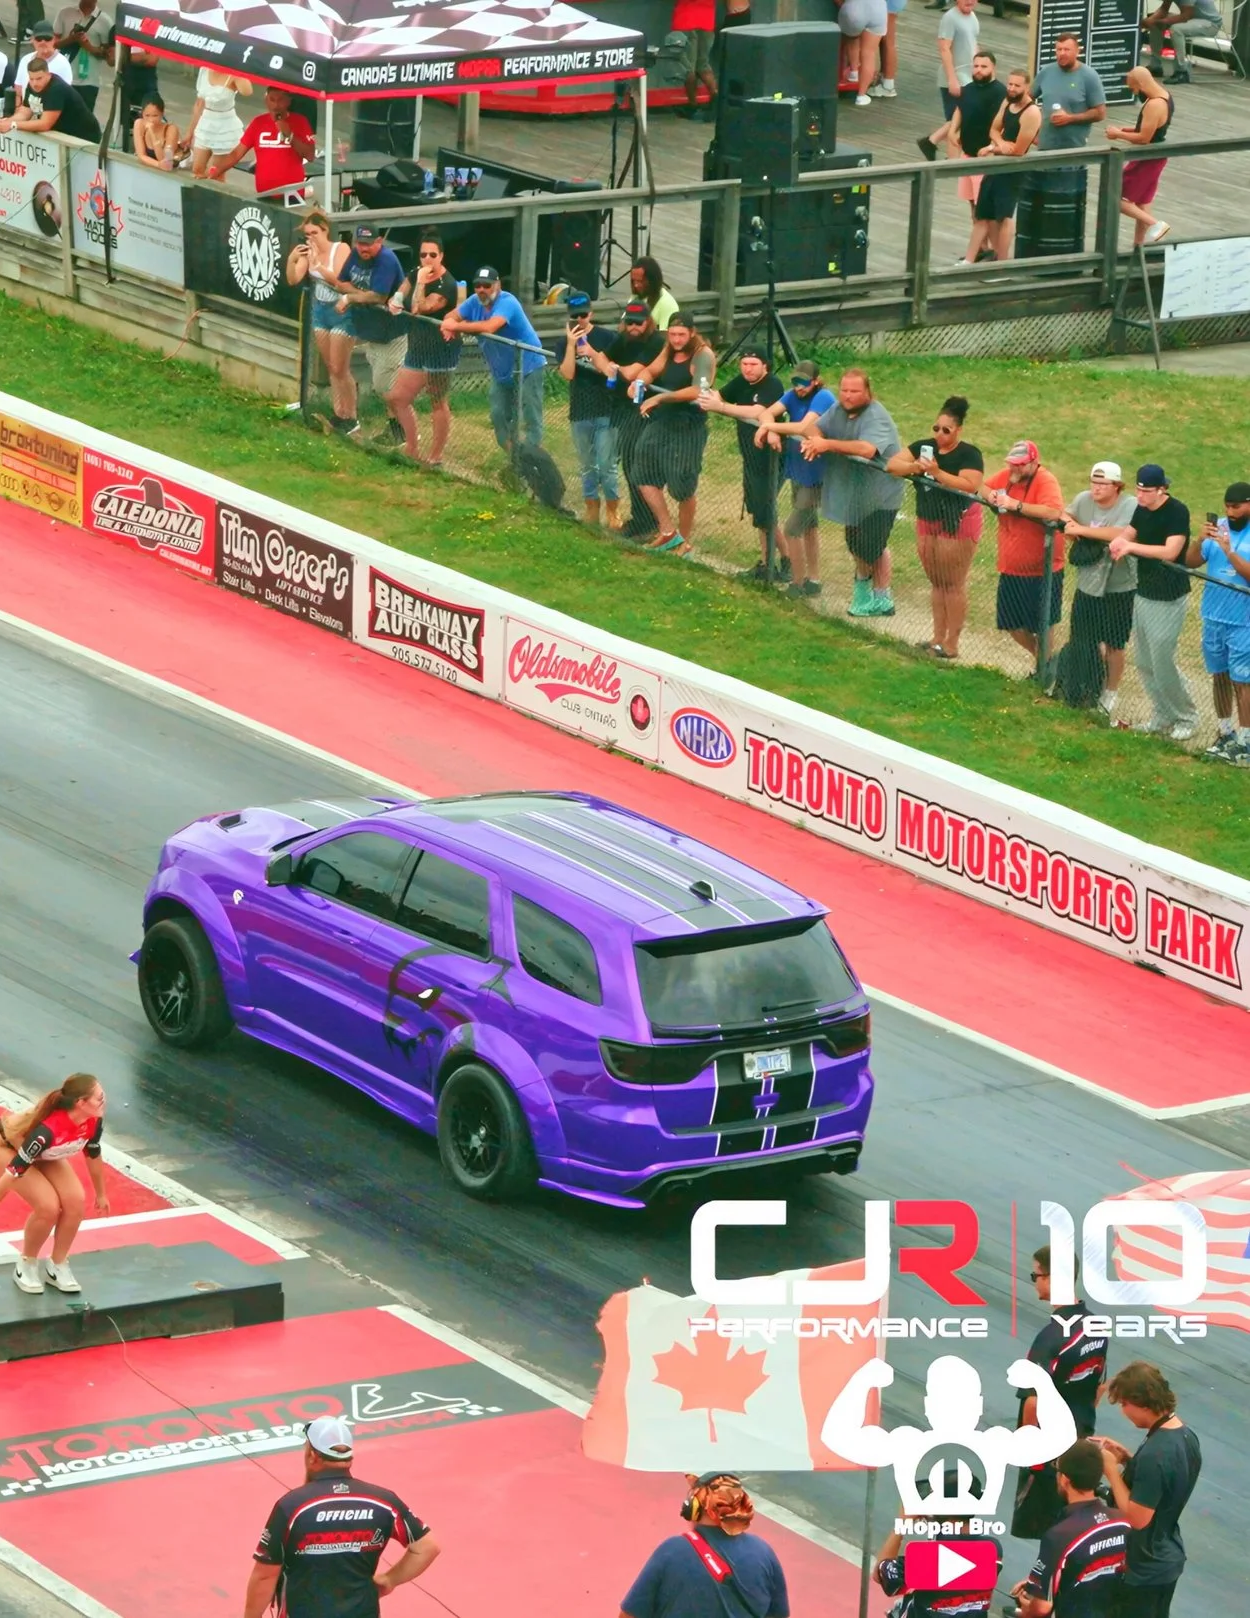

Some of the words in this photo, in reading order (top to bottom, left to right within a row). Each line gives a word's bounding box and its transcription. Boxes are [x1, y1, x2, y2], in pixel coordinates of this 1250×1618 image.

[341, 61, 397, 86] CANADA'S
[401, 61, 455, 82] ULTIMATE
[458, 58, 501, 78] MOPAR
[504, 51, 590, 76] PERFORMANCE
[594, 47, 635, 68] STORE
[15, 140, 24, 158] IT
[84, 217, 117, 237] MATO
[0, 420, 79, 476] broxtuning
[93, 492, 204, 539] CALEDONIA
[120, 523, 171, 543] AUTOMOTIVE
[220, 508, 263, 578] Tim
[374, 578, 480, 645] BREAKAWAY
[374, 614, 420, 642] AUTO
[426, 629, 479, 670] GLASS
[508, 635, 622, 697] Oldsmobile
[561, 698, 581, 714] CLUB
[679, 716, 728, 759] NHRA
[746, 728, 888, 842] TORONTO
[896, 789, 1138, 943] MOTORSPORTS
[1146, 888, 1244, 989] PARK
[7, 1393, 343, 1463] TORONTO
[41, 1427, 271, 1477] MOTORSPORTS
[316, 1508, 374, 1522] OFFICIAL
